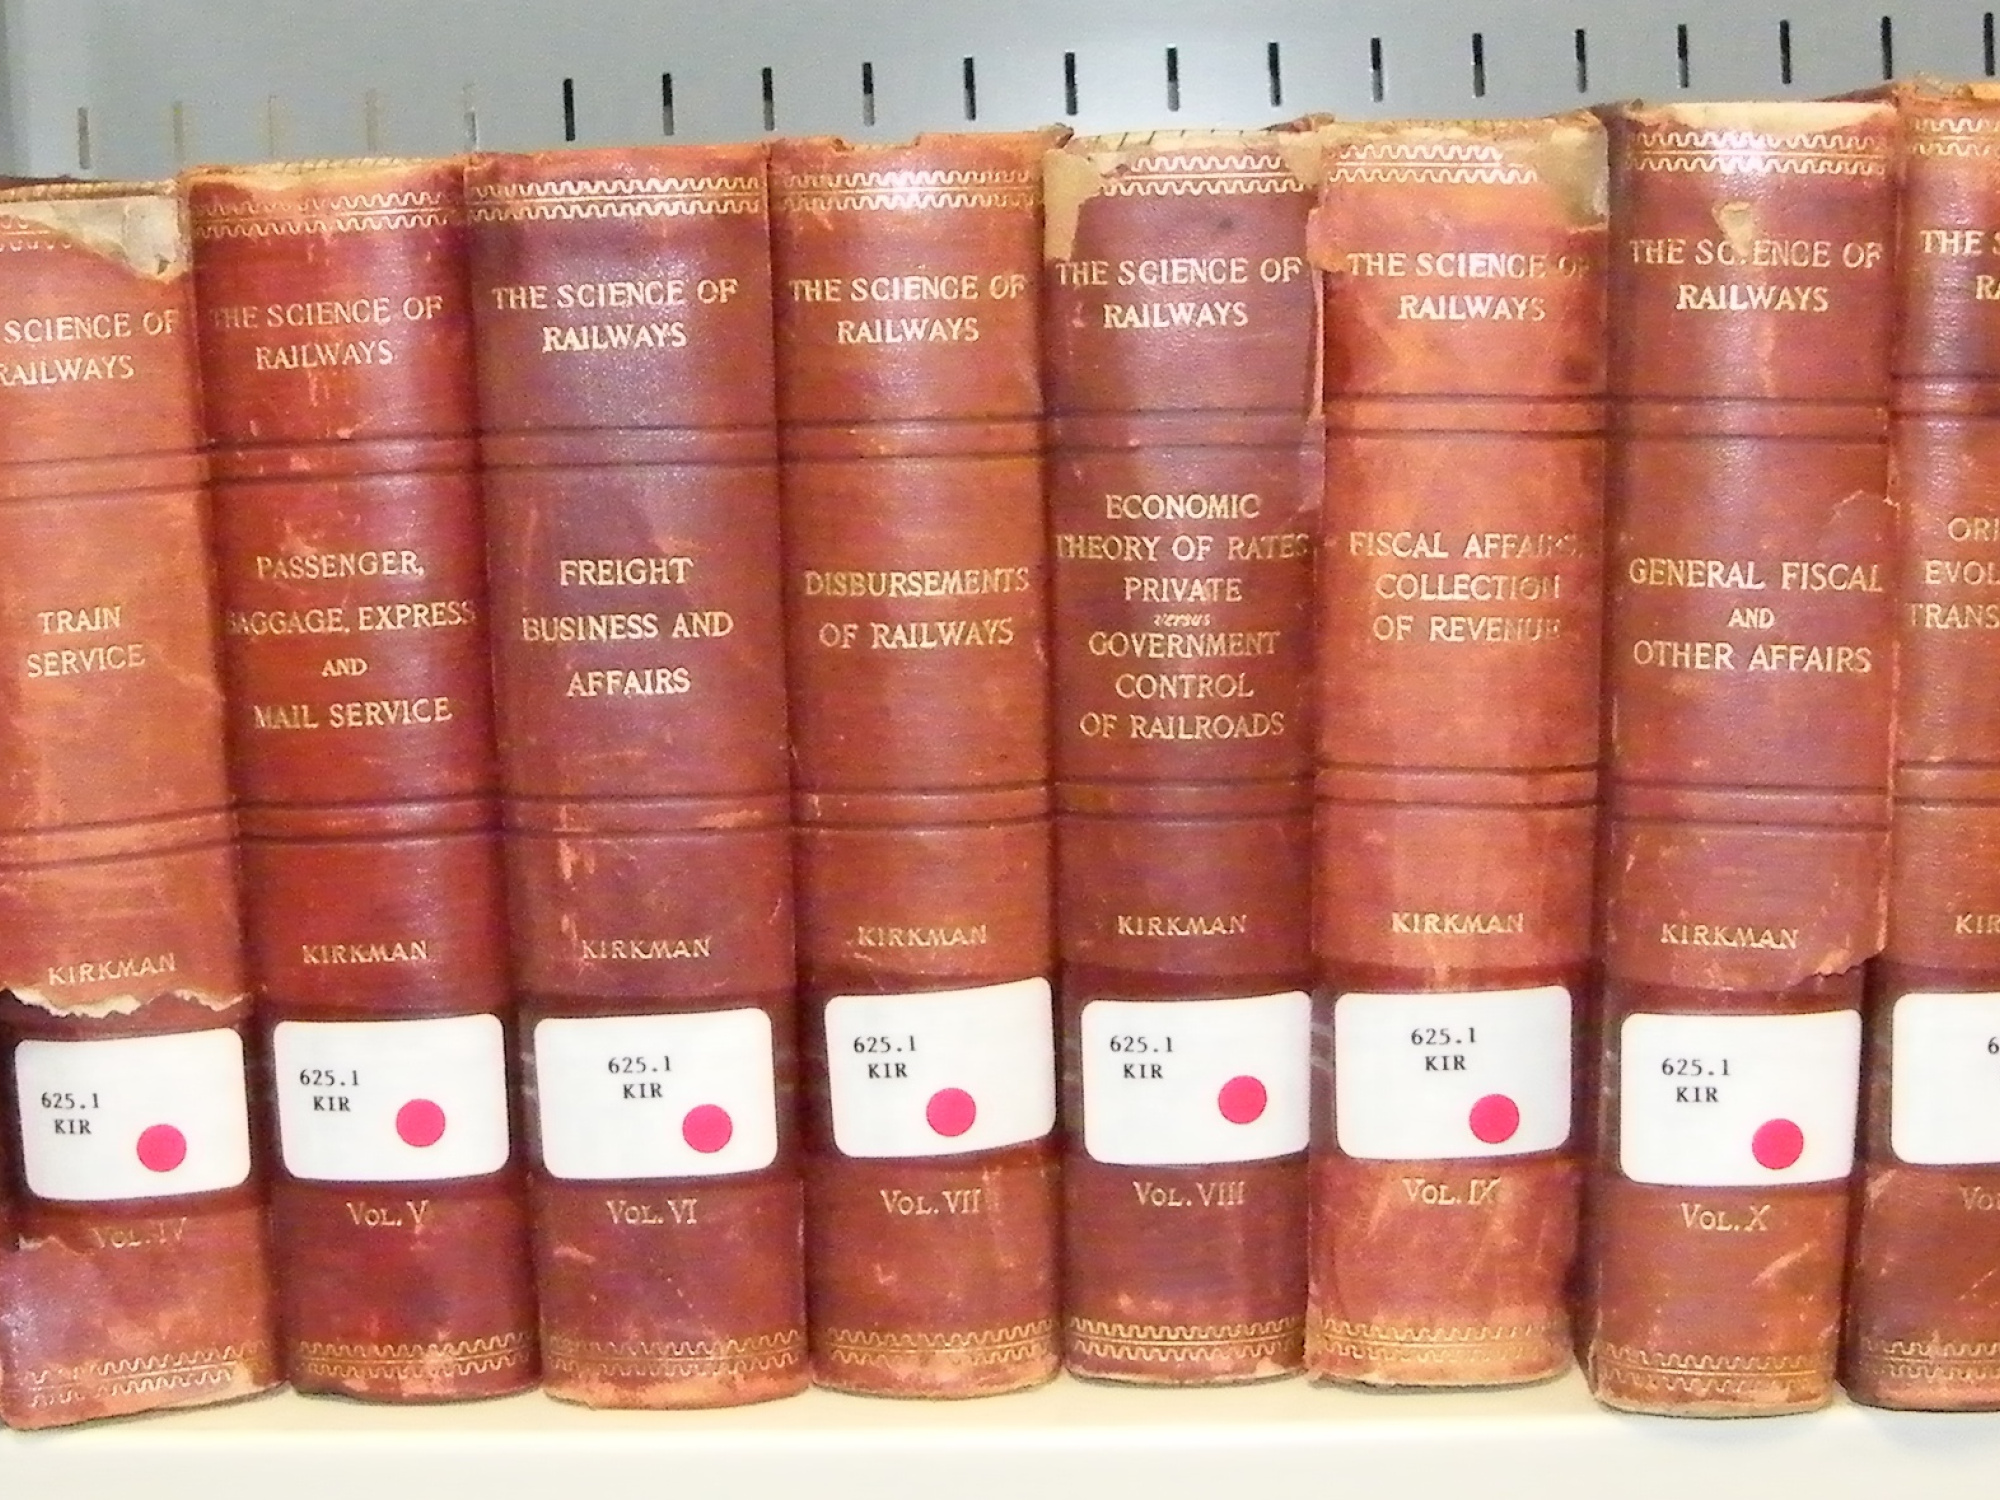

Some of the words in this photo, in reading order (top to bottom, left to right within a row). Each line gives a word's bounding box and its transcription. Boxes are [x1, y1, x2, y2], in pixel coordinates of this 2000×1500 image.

[1629, 239, 1686, 265] THE
[1695, 238, 1832, 268] SCENCE
[1842, 241, 1883, 269] OF
[1920, 229, 1985, 257] THE
[1057, 260, 1108, 286] THE
[1118, 258, 1248, 286] SCIENCE
[1260, 256, 1302, 283] OF
[1347, 253, 1406, 276] THE
[1415, 253, 1548, 279] SCIENCE
[492, 286, 548, 310] THE
[557, 280, 685, 308] SCIENCE
[697, 278, 738, 304] OF
[789, 278, 841, 302] THE
[851, 275, 980, 301] SCIENCE
[989, 274, 1026, 299] OF
[1676, 284, 1829, 312] RAILWAYS
[266, 297, 391, 328] SCIENCE
[402, 295, 444, 321] OF
[1103, 302, 1249, 328] RAILWAYS
[1397, 295, 1547, 321] RAILWAYS
[3, 313, 131, 344] SCIENCE
[143, 309, 179, 336] OF
[542, 322, 687, 353] RAILWAYS
[836, 317, 980, 344] RAILWAYS
[256, 339, 394, 370] RAILWAYS
[1105, 494, 1261, 520] ECONOMIC
[1057, 535, 1161, 561] THEORY
[1172, 535, 1214, 562] OF
[1228, 533, 1310, 561] RATES
[1350, 532, 1449, 558] FISCAL
[256, 550, 425, 579] PASSENGER,
[560, 557, 694, 586] FREIGHT
[1629, 558, 1766, 590] GENERAL
[1781, 562, 1883, 592] FISCAL
[805, 566, 1029, 595] DISBURSEMENTS
[1124, 576, 1243, 603] PRIVATE
[1375, 573, 1560, 601] COLLECTION
[38, 606, 122, 634] TRAIN
[358, 601, 476, 631] EXPRESS
[523, 612, 659, 641] BUSINESS
[672, 611, 734, 638] AND
[1373, 615, 1414, 641] OF
[1728, 608, 1775, 628] AND
[819, 622, 857, 648] OF
[871, 617, 1014, 649] RAILWAYS
[1089, 631, 1281, 658] GOVERNMENT
[27, 644, 145, 678] SERVICE
[321, 658, 368, 677] AND
[1633, 641, 1734, 669] OTHER
[1748, 645, 1872, 673] AFFAIRS
[566, 667, 691, 697] AFFAIRS
[1115, 673, 1255, 700] CONTROL
[253, 705, 319, 730] MAIL
[329, 697, 453, 728] SERVICE
[1079, 712, 1118, 738] OF
[1130, 711, 1285, 740] RAILROADS
[857, 924, 988, 948] KIRKMAN
[1117, 914, 1248, 936] KIRKMAN
[1391, 911, 1524, 935] KIRKMAN
[1661, 923, 1800, 949] KIRKMAN
[303, 940, 429, 964] KIRKMAN
[582, 937, 712, 960] KIRKMAN
[48, 953, 177, 985] KIRKMAN
[853, 1036, 917, 1054] 625.1
[1109, 1036, 1174, 1053] 625.1
[1410, 1027, 1477, 1046] 625.1
[607, 1056, 671, 1074] 625.1
[867, 1062, 908, 1079] KIR
[1123, 1063, 1164, 1080] KIR
[1425, 1055, 1467, 1072] KIR
[1661, 1058, 1731, 1077] 625.1
[300, 1070, 359, 1087] 625.1
[622, 1083, 663, 1100] KIR
[41, 1092, 100, 1110] 625.1
[313, 1096, 351, 1113] KIR
[1675, 1086, 1720, 1104] KIR
[54, 1120, 92, 1136] KIR
